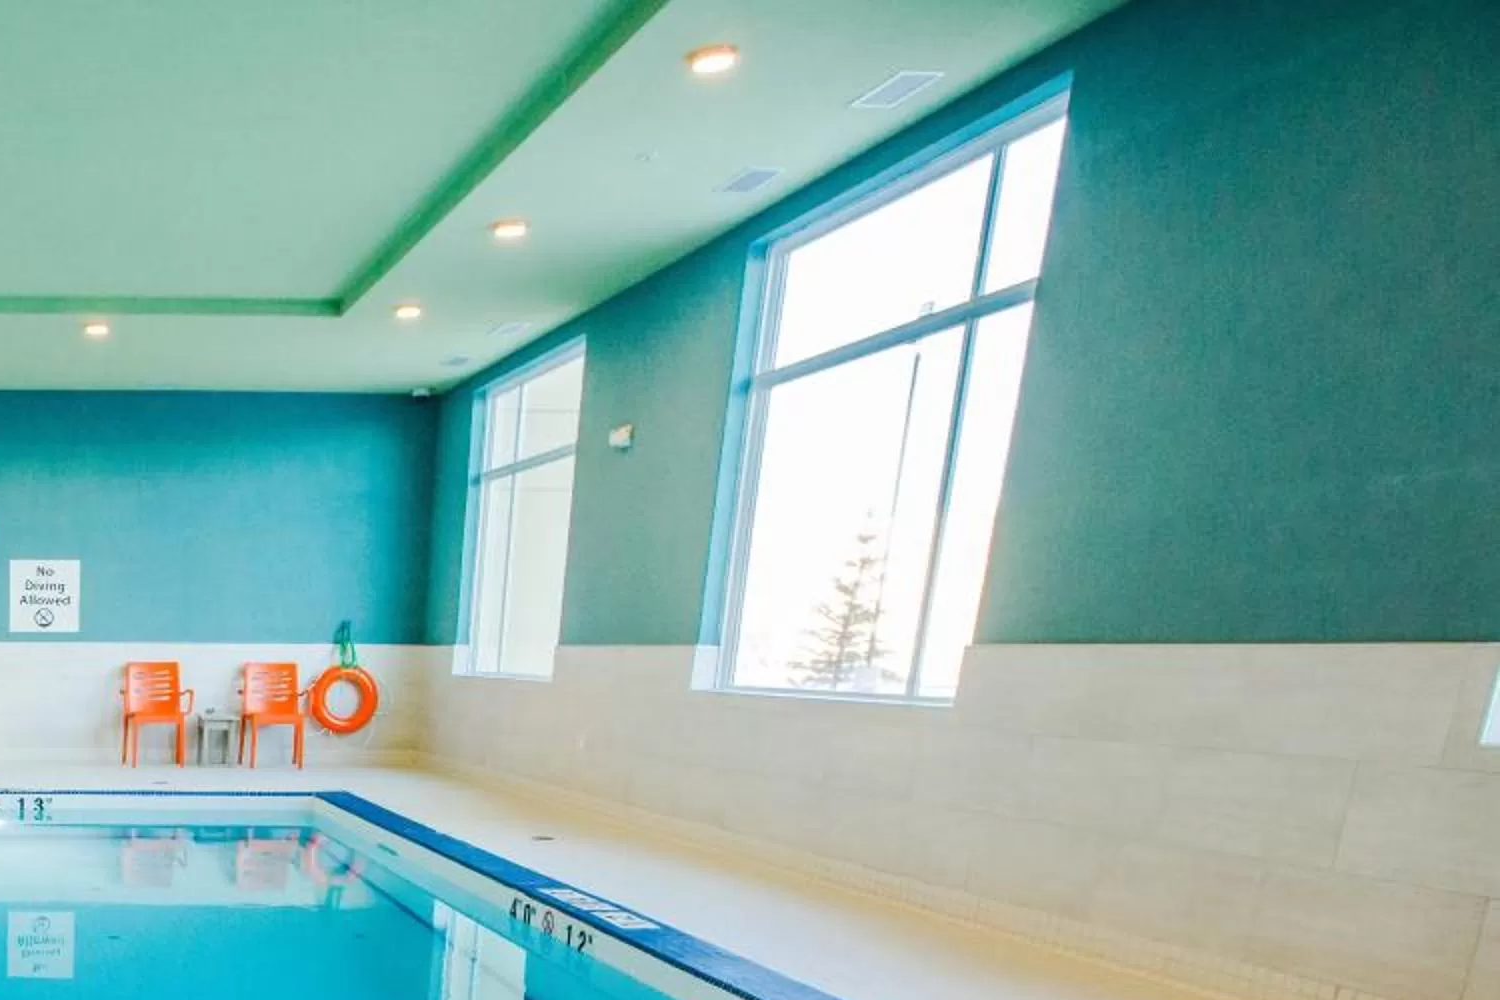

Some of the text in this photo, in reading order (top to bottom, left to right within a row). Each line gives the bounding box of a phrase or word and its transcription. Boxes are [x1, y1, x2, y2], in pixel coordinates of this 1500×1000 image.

[36, 565, 55, 577] No
[25, 579, 65, 594] Diving
[19, 595, 71, 606] Allowed
